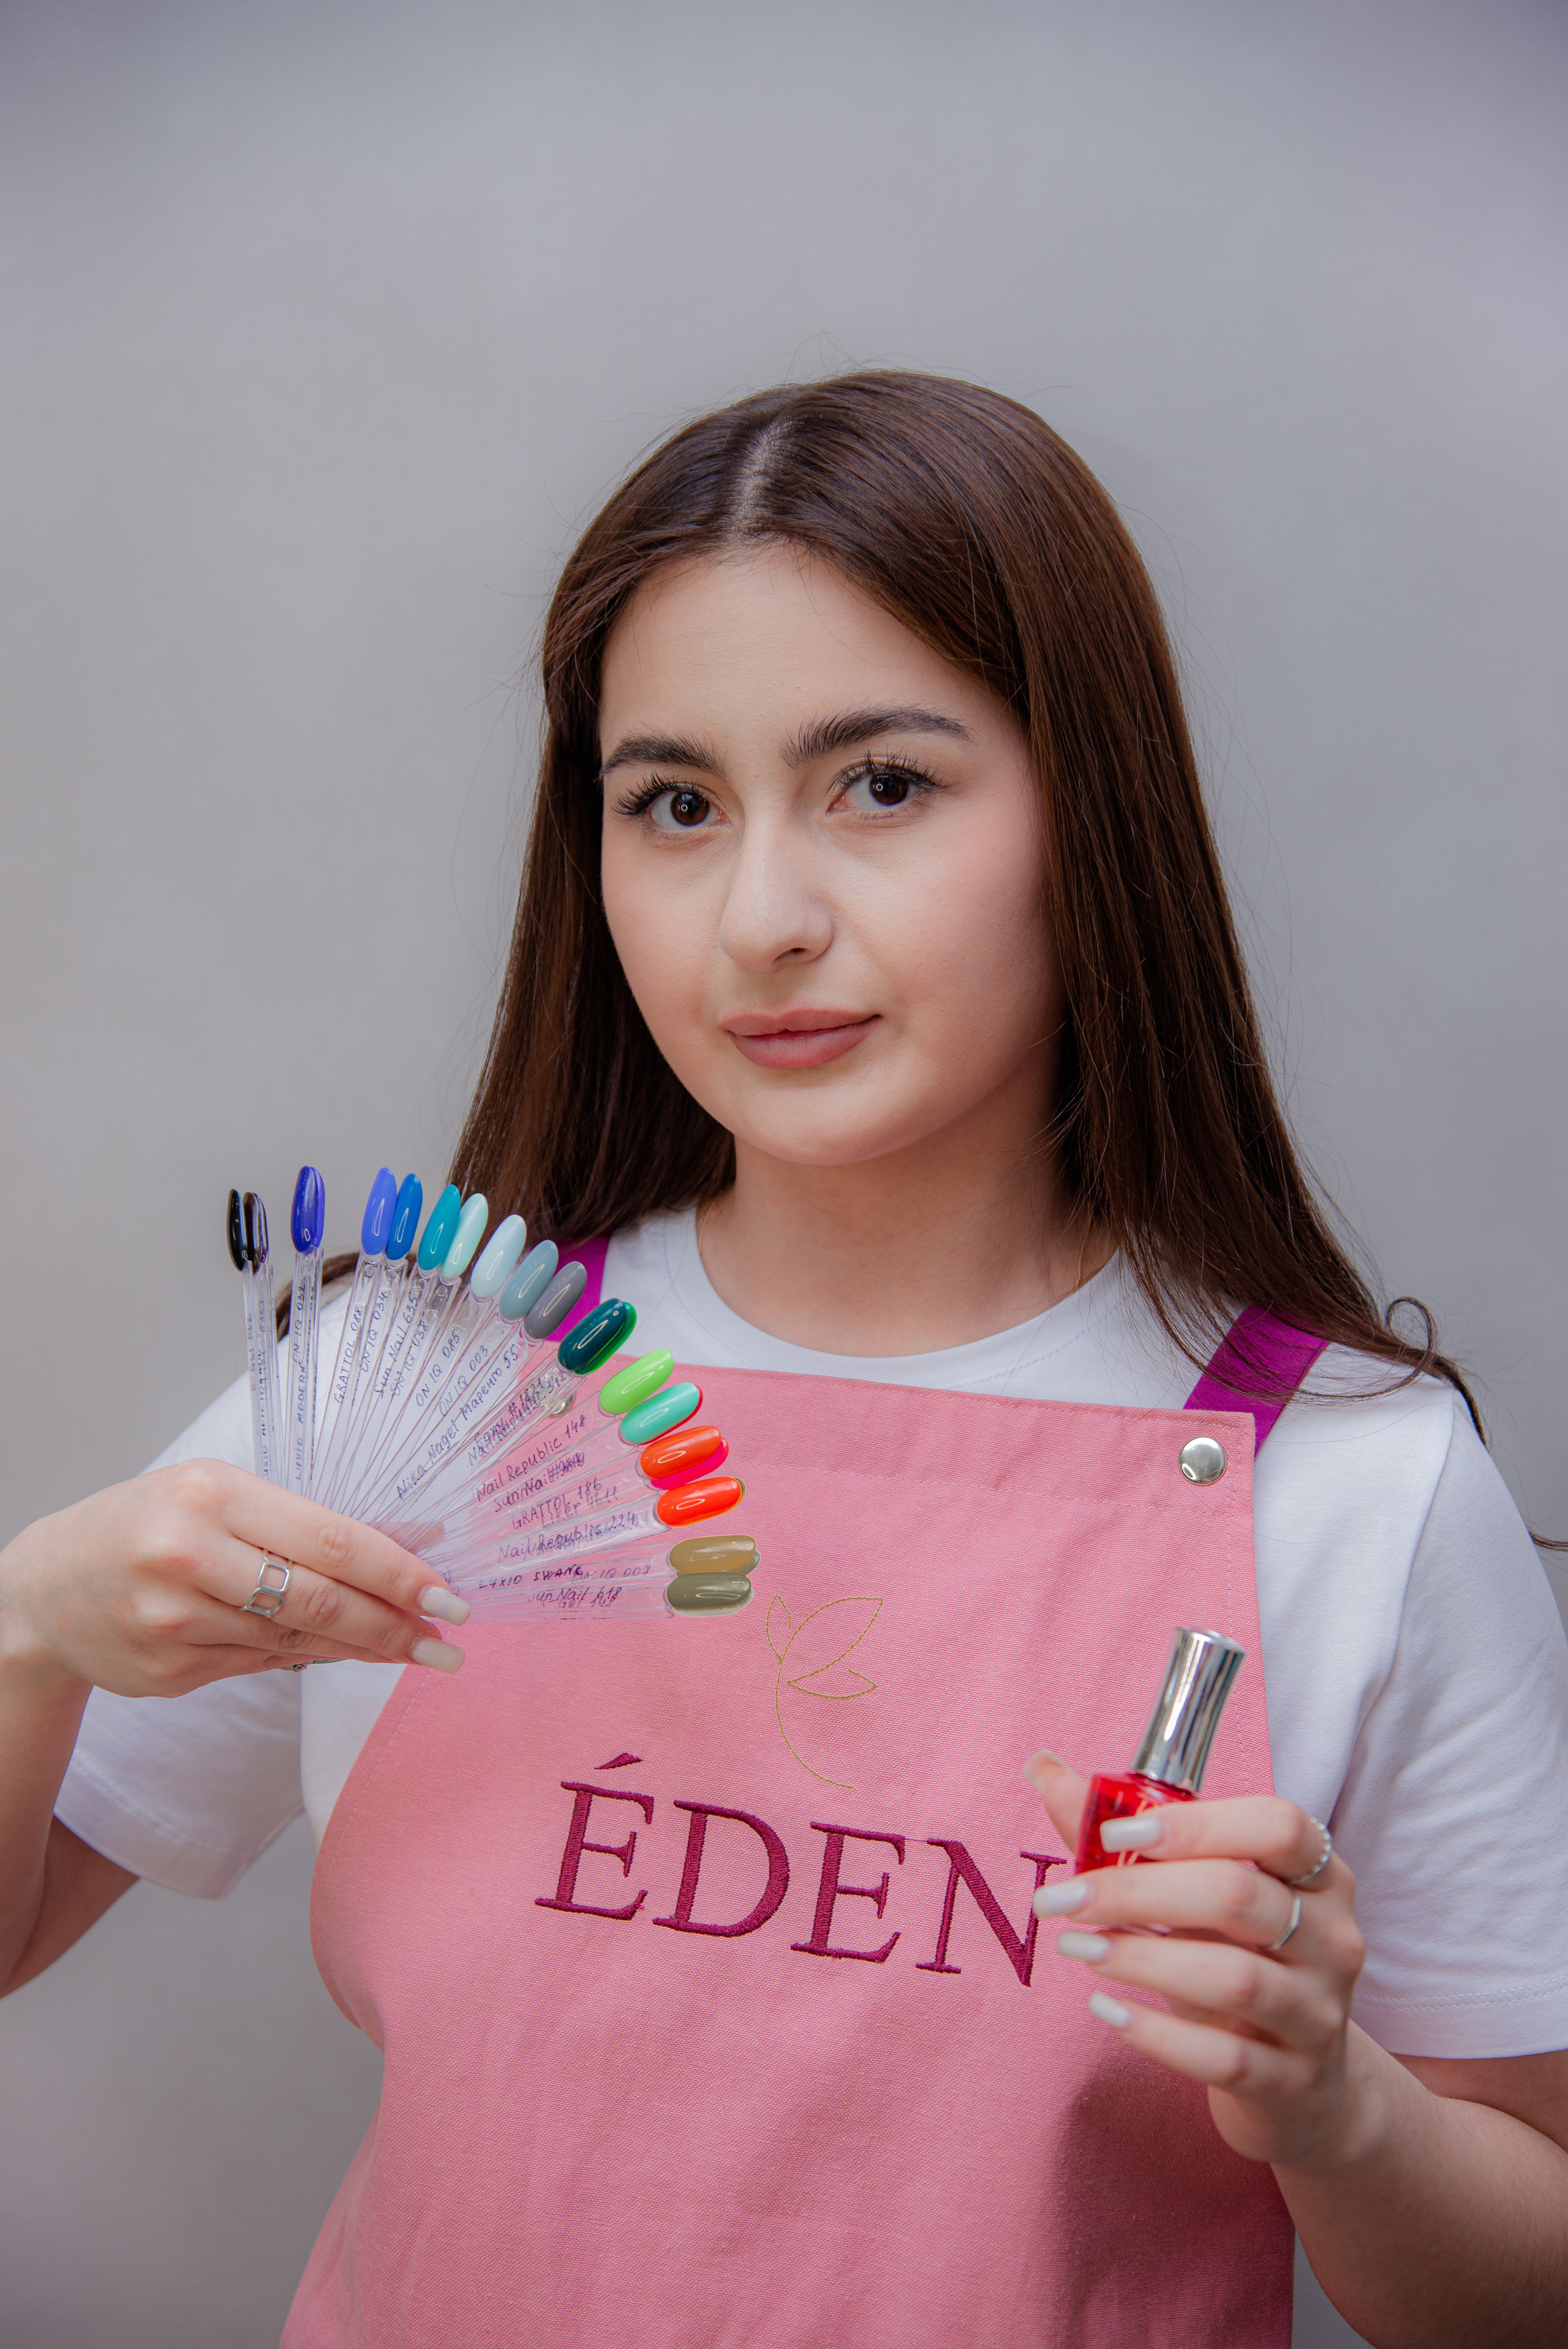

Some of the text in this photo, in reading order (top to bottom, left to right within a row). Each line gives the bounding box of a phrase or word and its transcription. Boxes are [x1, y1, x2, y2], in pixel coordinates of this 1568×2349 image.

[296, 1284, 305, 1311] 032
[374, 1291, 418, 1399] Sun Nail 635
[412, 1319, 429, 1347] 038
[442, 1328, 460, 1359] 085
[334, 1306, 363, 1404] GRATTOL 088
[469, 1345, 489, 1372] 003
[396, 1464, 428, 1499] Nika
[428, 1418, 459, 1464] Nagel
[503, 1344, 518, 1369] 55
[475, 1472, 504, 1502] Nail
[506, 1438, 562, 1481] Republic
[565, 1414, 585, 1439] 148
[511, 1477, 602, 1530] GRATTOL 186
[497, 1537, 531, 1563] Nail
[533, 1564, 584, 1583] SWANK
[556, 1586, 586, 1602] Nail
[536, 1752, 1067, 1987] ÉDEN
